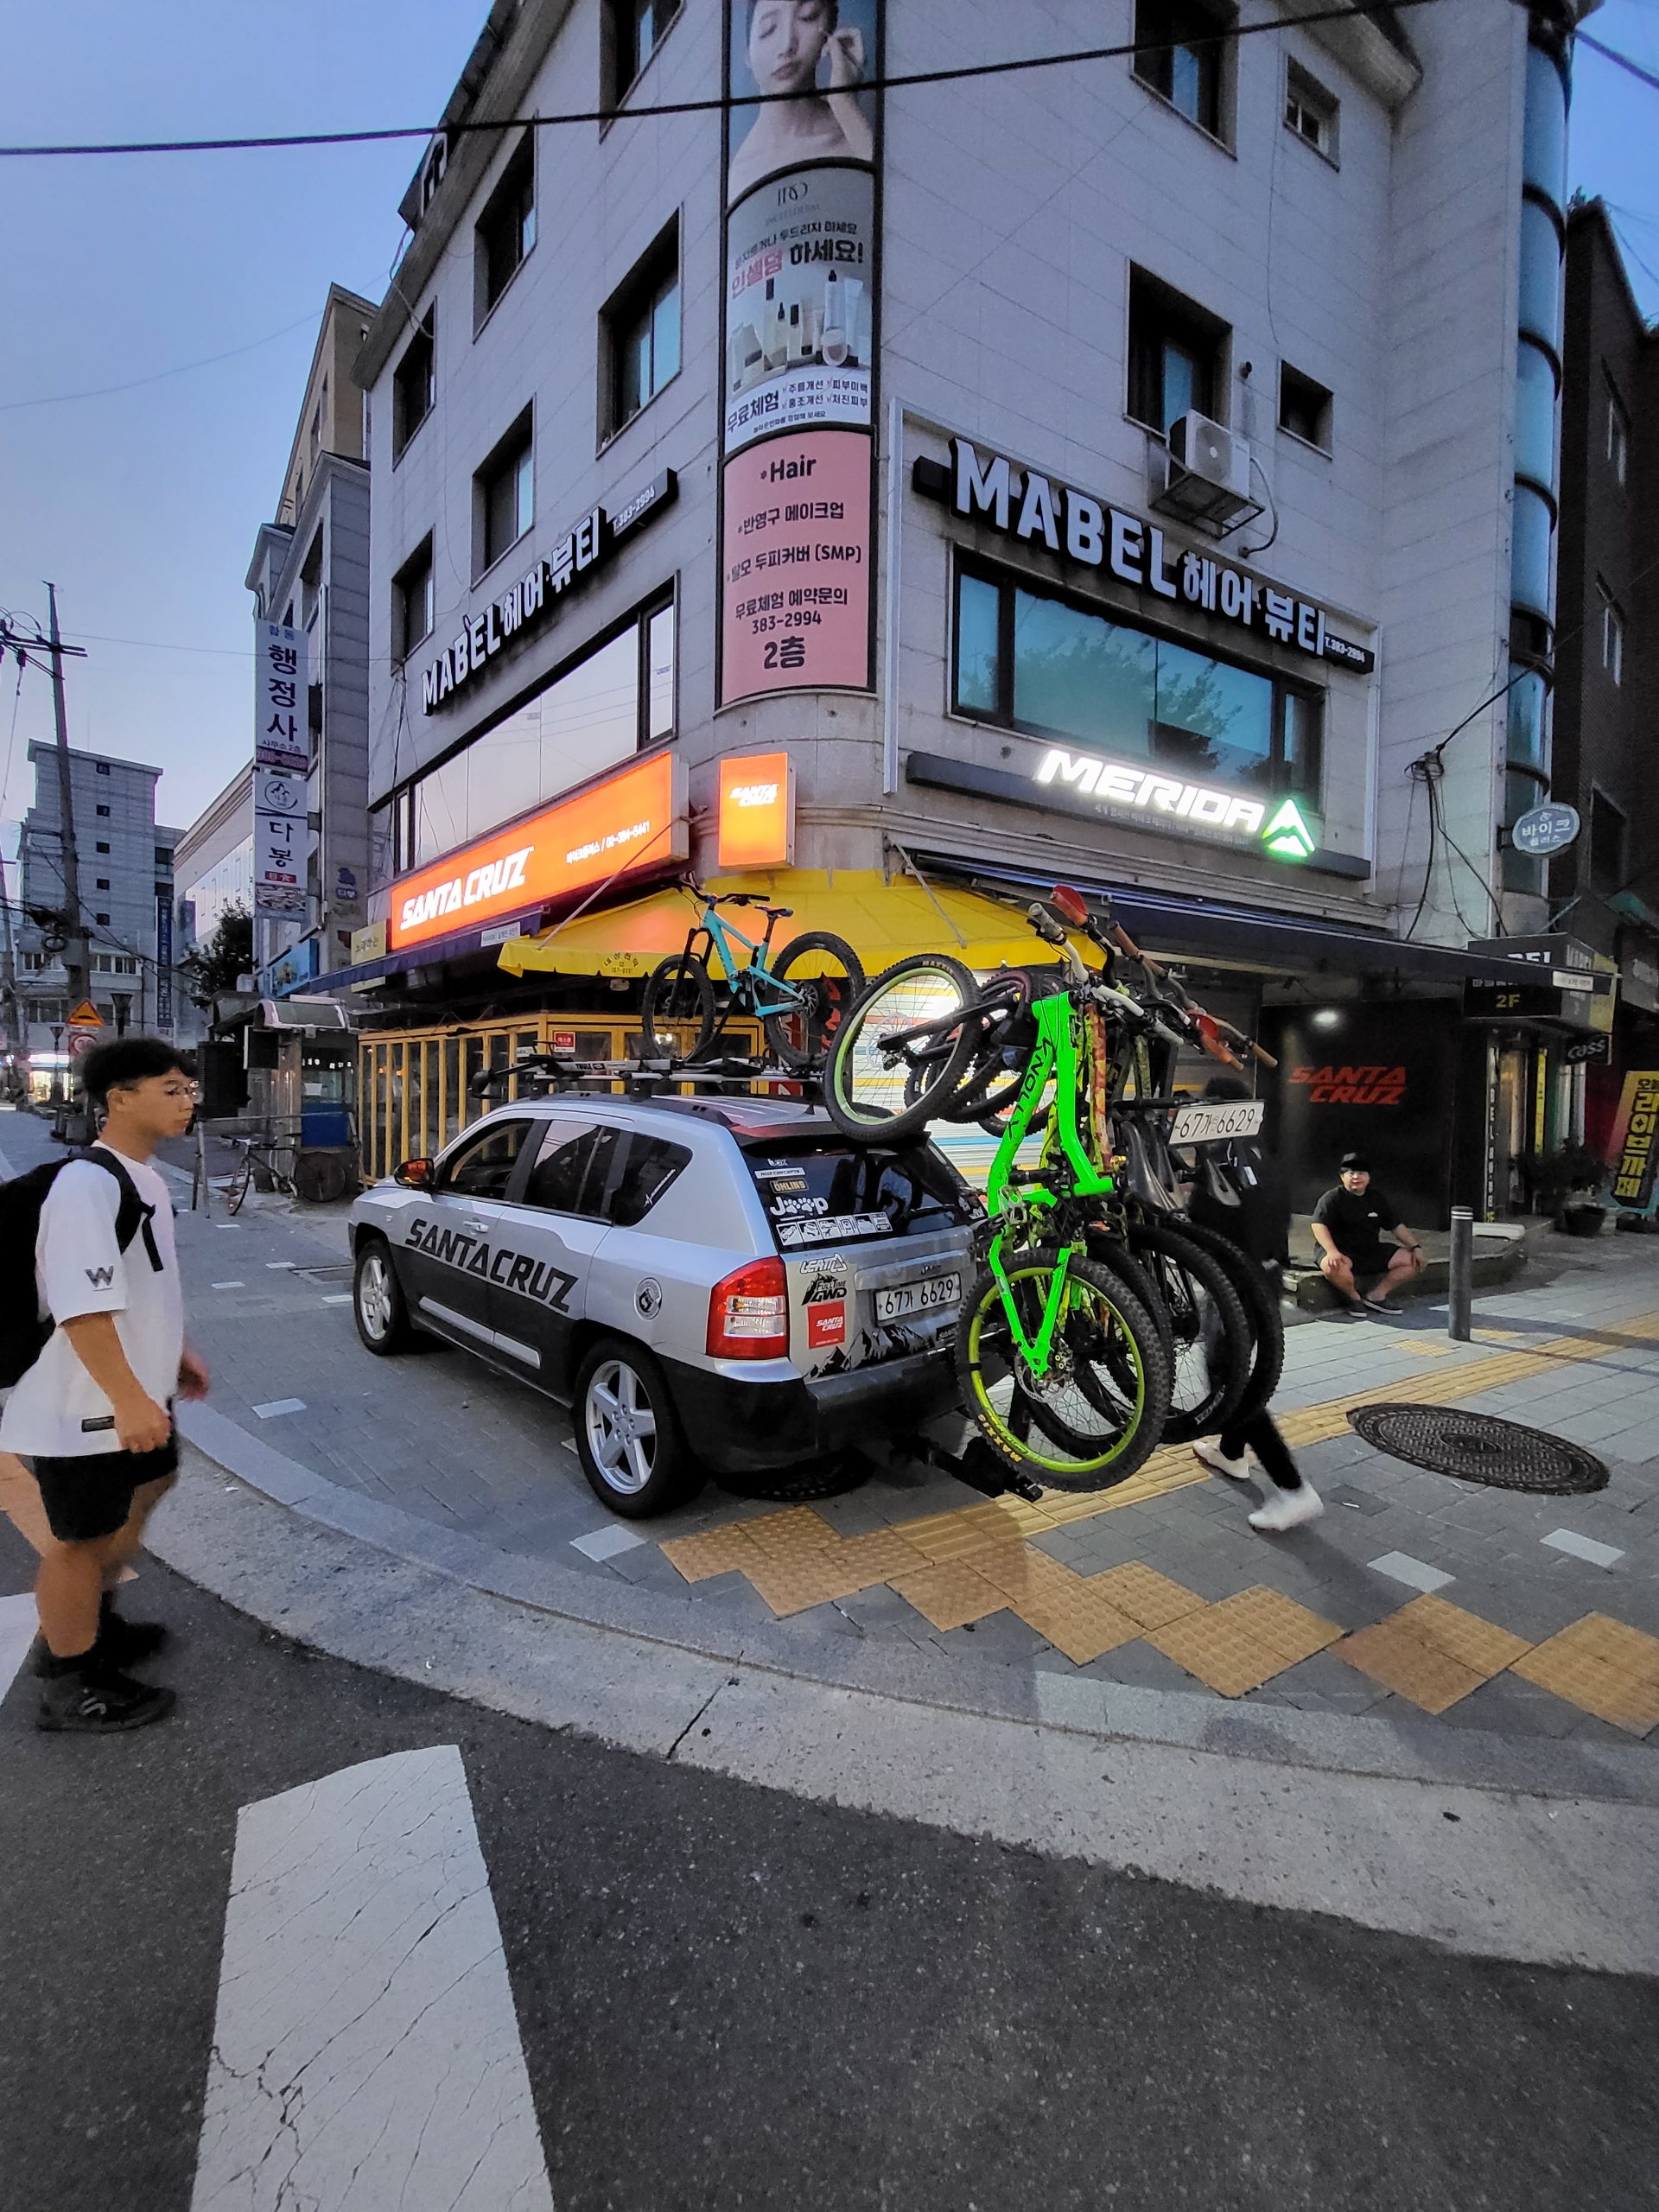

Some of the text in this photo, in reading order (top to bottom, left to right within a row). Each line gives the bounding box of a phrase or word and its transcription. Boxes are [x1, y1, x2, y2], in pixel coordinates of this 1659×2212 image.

[824, 220, 857, 235] 마세요
[790, 238, 864, 266] 하세요!
[788, 379, 868, 395] 주름개선 피부미백
[727, 390, 779, 433] 무료체험
[788, 394, 868, 410] 홍조개선 처진피부
[785, 502, 844, 522] 메이크업
[953, 435, 1177, 600] MABEL
[754, 544, 810, 571] 두피커버
[815, 543, 862, 564] (SMP)
[735, 588, 848, 620] 무료체험 예약문의
[752, 610, 823, 635] 383-2994
[421, 603, 500, 717] MABEL
[764, 635, 805, 670] 2층
[267, 644, 297, 742] 행정사
[1036, 748, 1266, 833] MERIDA
[1522, 819, 1571, 836] 바이크
[400, 845, 533, 931] SANTA CRUZ
[1496, 994, 1521, 1007] 2F
[1288, 1065, 1406, 1084] SANTA
[1310, 1085, 1407, 1104] CRUZ
[1217, 1108, 1255, 1134] 6629
[810, 1287, 848, 1303] 4WD
[885, 1279, 954, 1314] 67가 6629
[816, 1316, 843, 1326] SANTA
[822, 1322, 843, 1332] CRUZ
